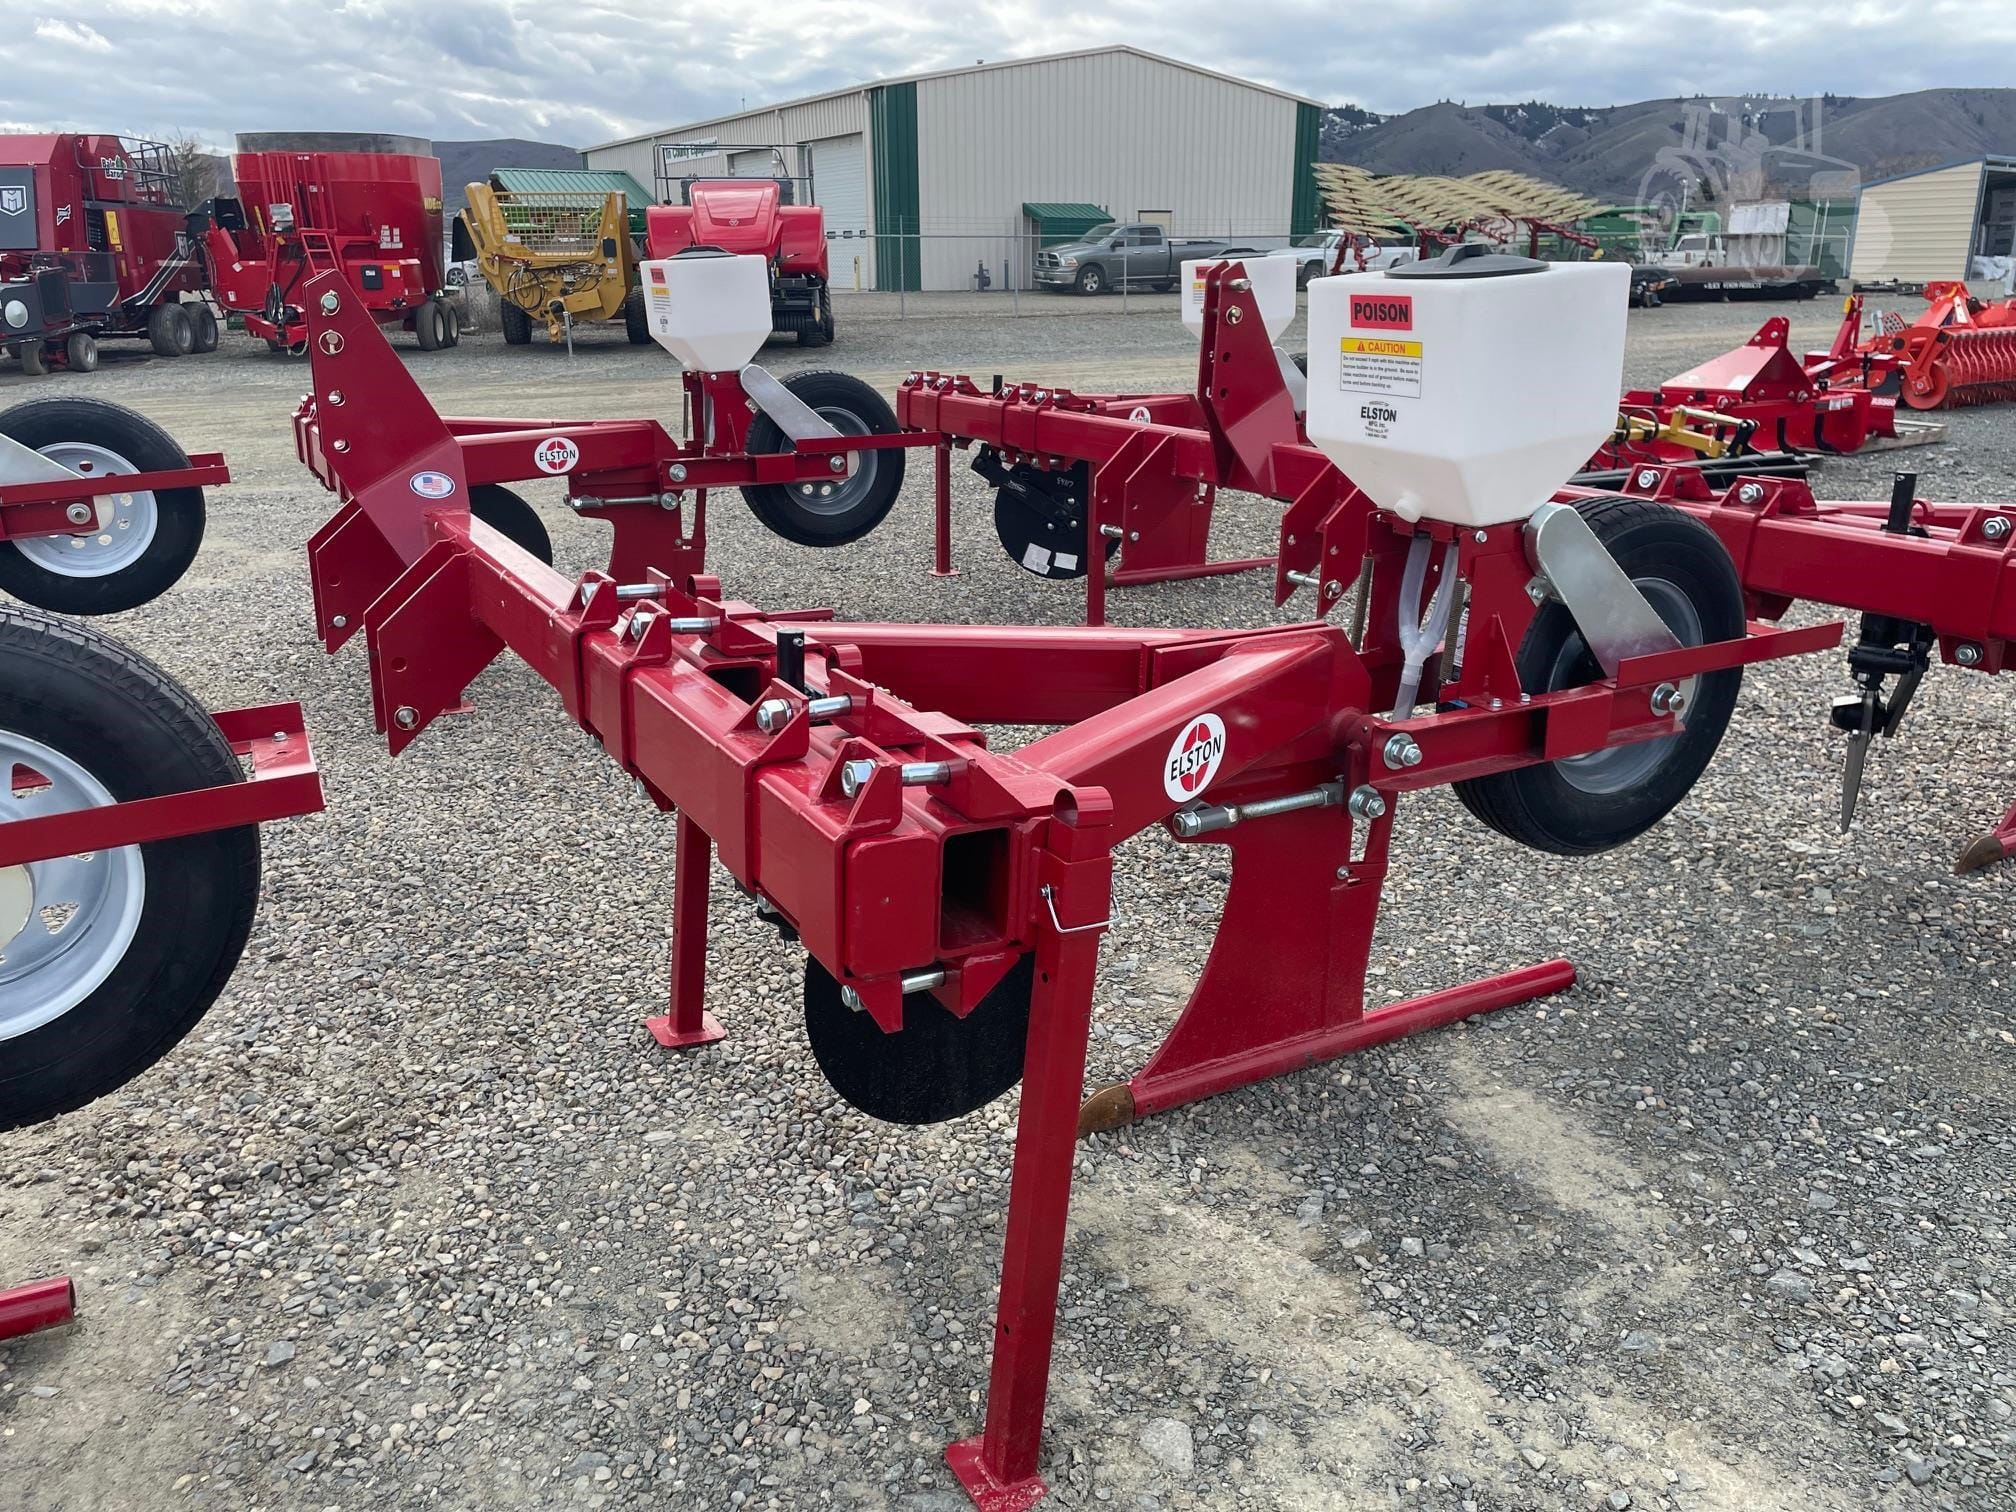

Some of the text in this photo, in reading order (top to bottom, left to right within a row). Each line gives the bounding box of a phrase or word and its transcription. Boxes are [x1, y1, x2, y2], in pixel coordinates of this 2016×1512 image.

[1354, 302, 1409, 323] POISON
[1368, 342, 1406, 353] CAUTION
[1361, 406, 1397, 423] ELSTON
[539, 449, 576, 461] ELSTON
[1171, 734, 1222, 782] ELSTON
